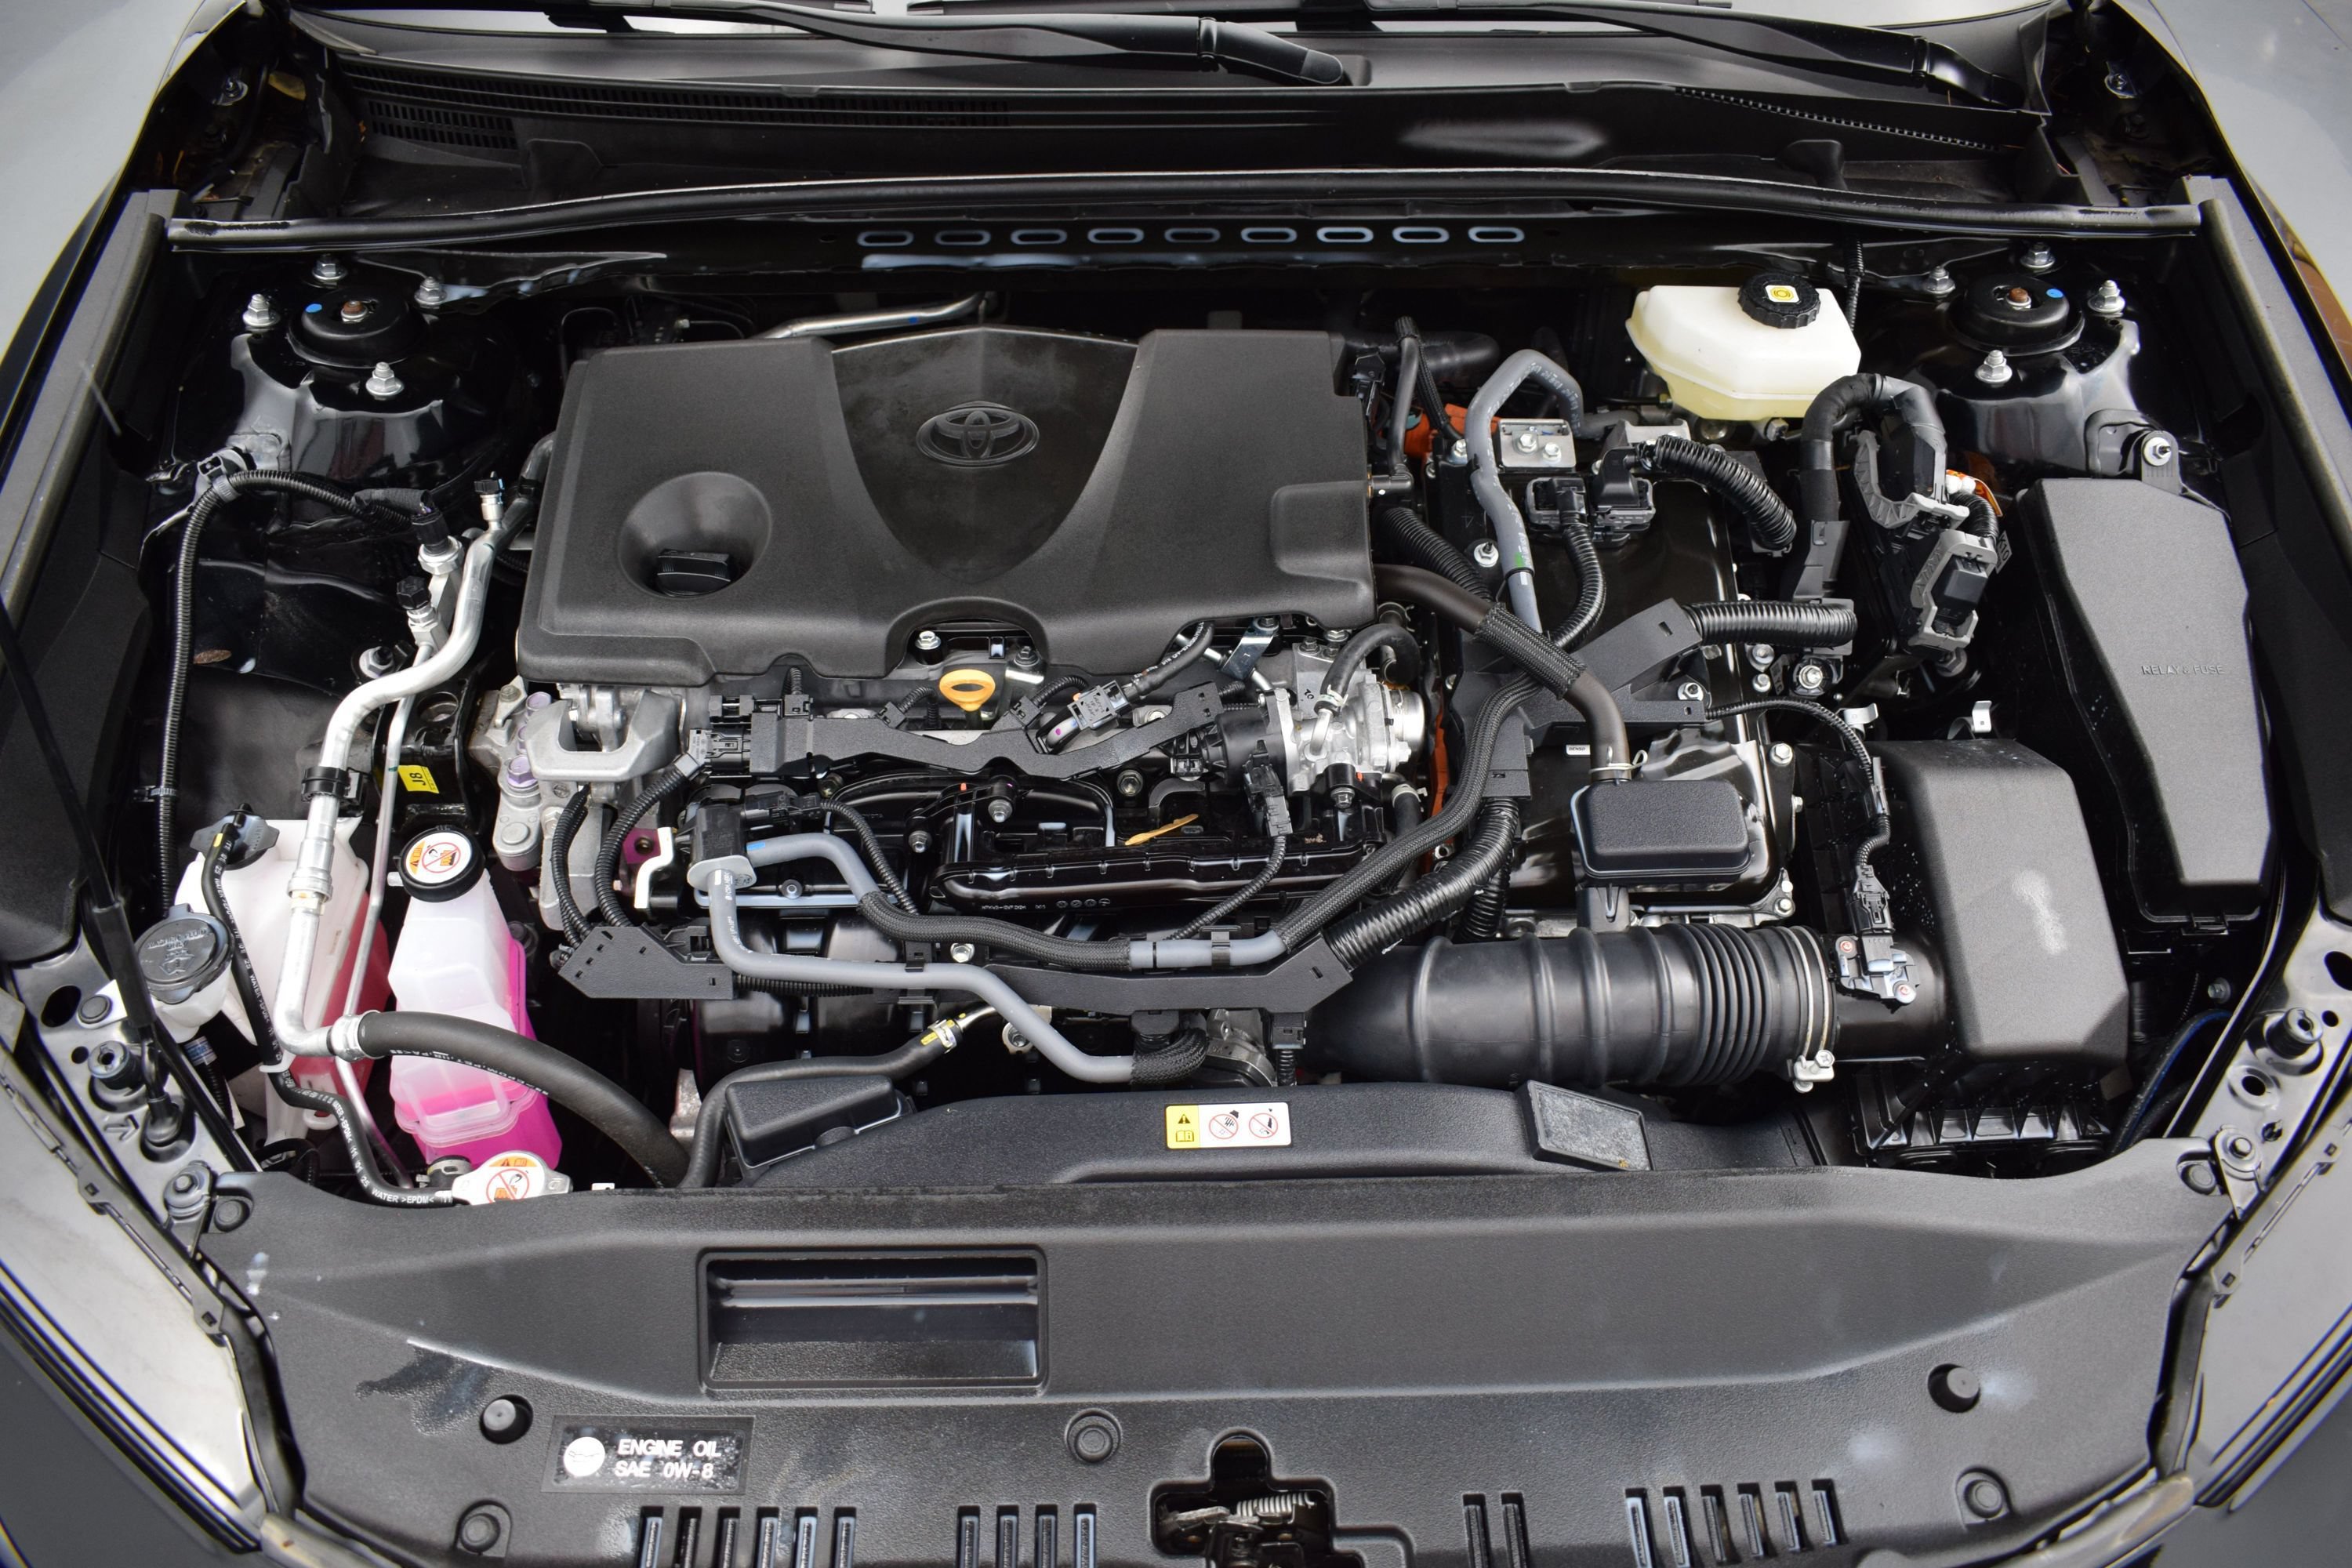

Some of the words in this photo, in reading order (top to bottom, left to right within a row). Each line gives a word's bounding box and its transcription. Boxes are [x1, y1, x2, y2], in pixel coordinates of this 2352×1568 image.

[1998, 535, 2010, 561] K10
[2141, 665, 2180, 675] RELAY
[2182, 666, 2190, 675] &
[2193, 665, 2225, 675] FUSE
[410, 772, 426, 786] J8
[214, 878, 226, 899] WATER
[249, 974, 262, 998] WATER
[360, 1176, 371, 1188] 25
[372, 1188, 399, 1203] WATER
[401, 1196, 434, 1204] >EPDM<
[618, 1439, 683, 1457] ENGINE
[693, 1441, 721, 1457] OIL
[615, 1461, 651, 1478] SAE
[663, 1462, 713, 1479] 0W-8
